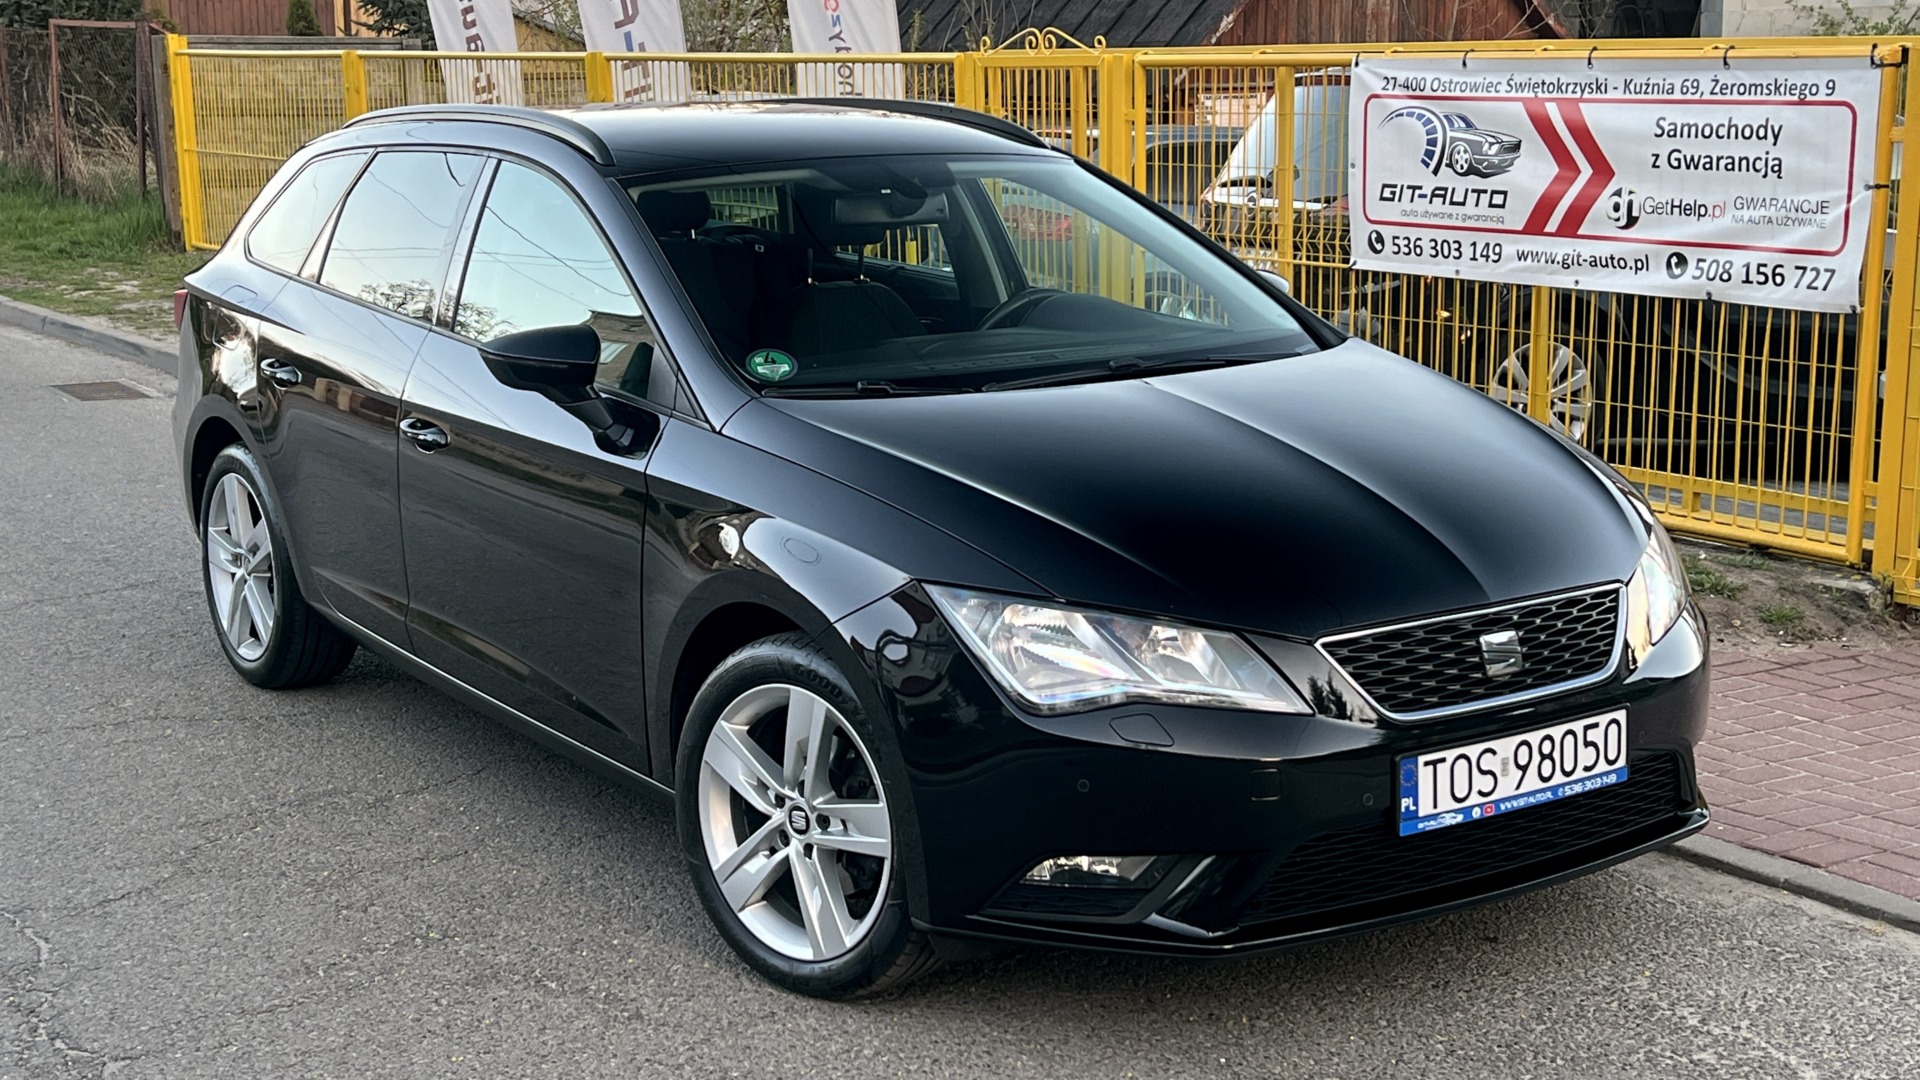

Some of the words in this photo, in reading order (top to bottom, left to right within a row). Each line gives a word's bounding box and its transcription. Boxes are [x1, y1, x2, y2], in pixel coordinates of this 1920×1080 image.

[1381, 76, 1426, 92] 27-400
[1430, 77, 1502, 94] Ostrowiec
[1505, 74, 1608, 98] Świętokrzyski
[1623, 77, 1675, 96] Kuźnia
[1680, 78, 1704, 98] 69,
[1709, 75, 1820, 100] Żeromskiego
[1825, 79, 1836, 96] 9
[1654, 116, 1783, 146] Samochody
[1651, 152, 1661, 169] z
[1667, 149, 1783, 179] Gwarancją
[1378, 183, 1509, 209] GIT-AUTO
[1643, 196, 1727, 221] GetHelp.pl
[1733, 196, 1830, 215] GWARANCJE
[1400, 208, 1419, 218] auta
[1420, 209, 1454, 222] używane
[1461, 212, 1505, 225] gwarancją
[1731, 214, 1745, 225] NA
[1746, 215, 1774, 226] AUTA
[1776, 214, 1827, 229] UŻYWANE
[1391, 236, 1423, 257] 536
[1429, 238, 1463, 260] 303
[1469, 241, 1503, 263] 149
[1516, 249, 1649, 275] www.git-auto.pl
[1691, 258, 1734, 283] 508
[1741, 263, 1786, 287] 156
[1793, 265, 1836, 291] 727
[1423, 747, 1498, 810] TOS
[1514, 717, 1621, 791] 98050
[1401, 796, 1417, 813] PL
